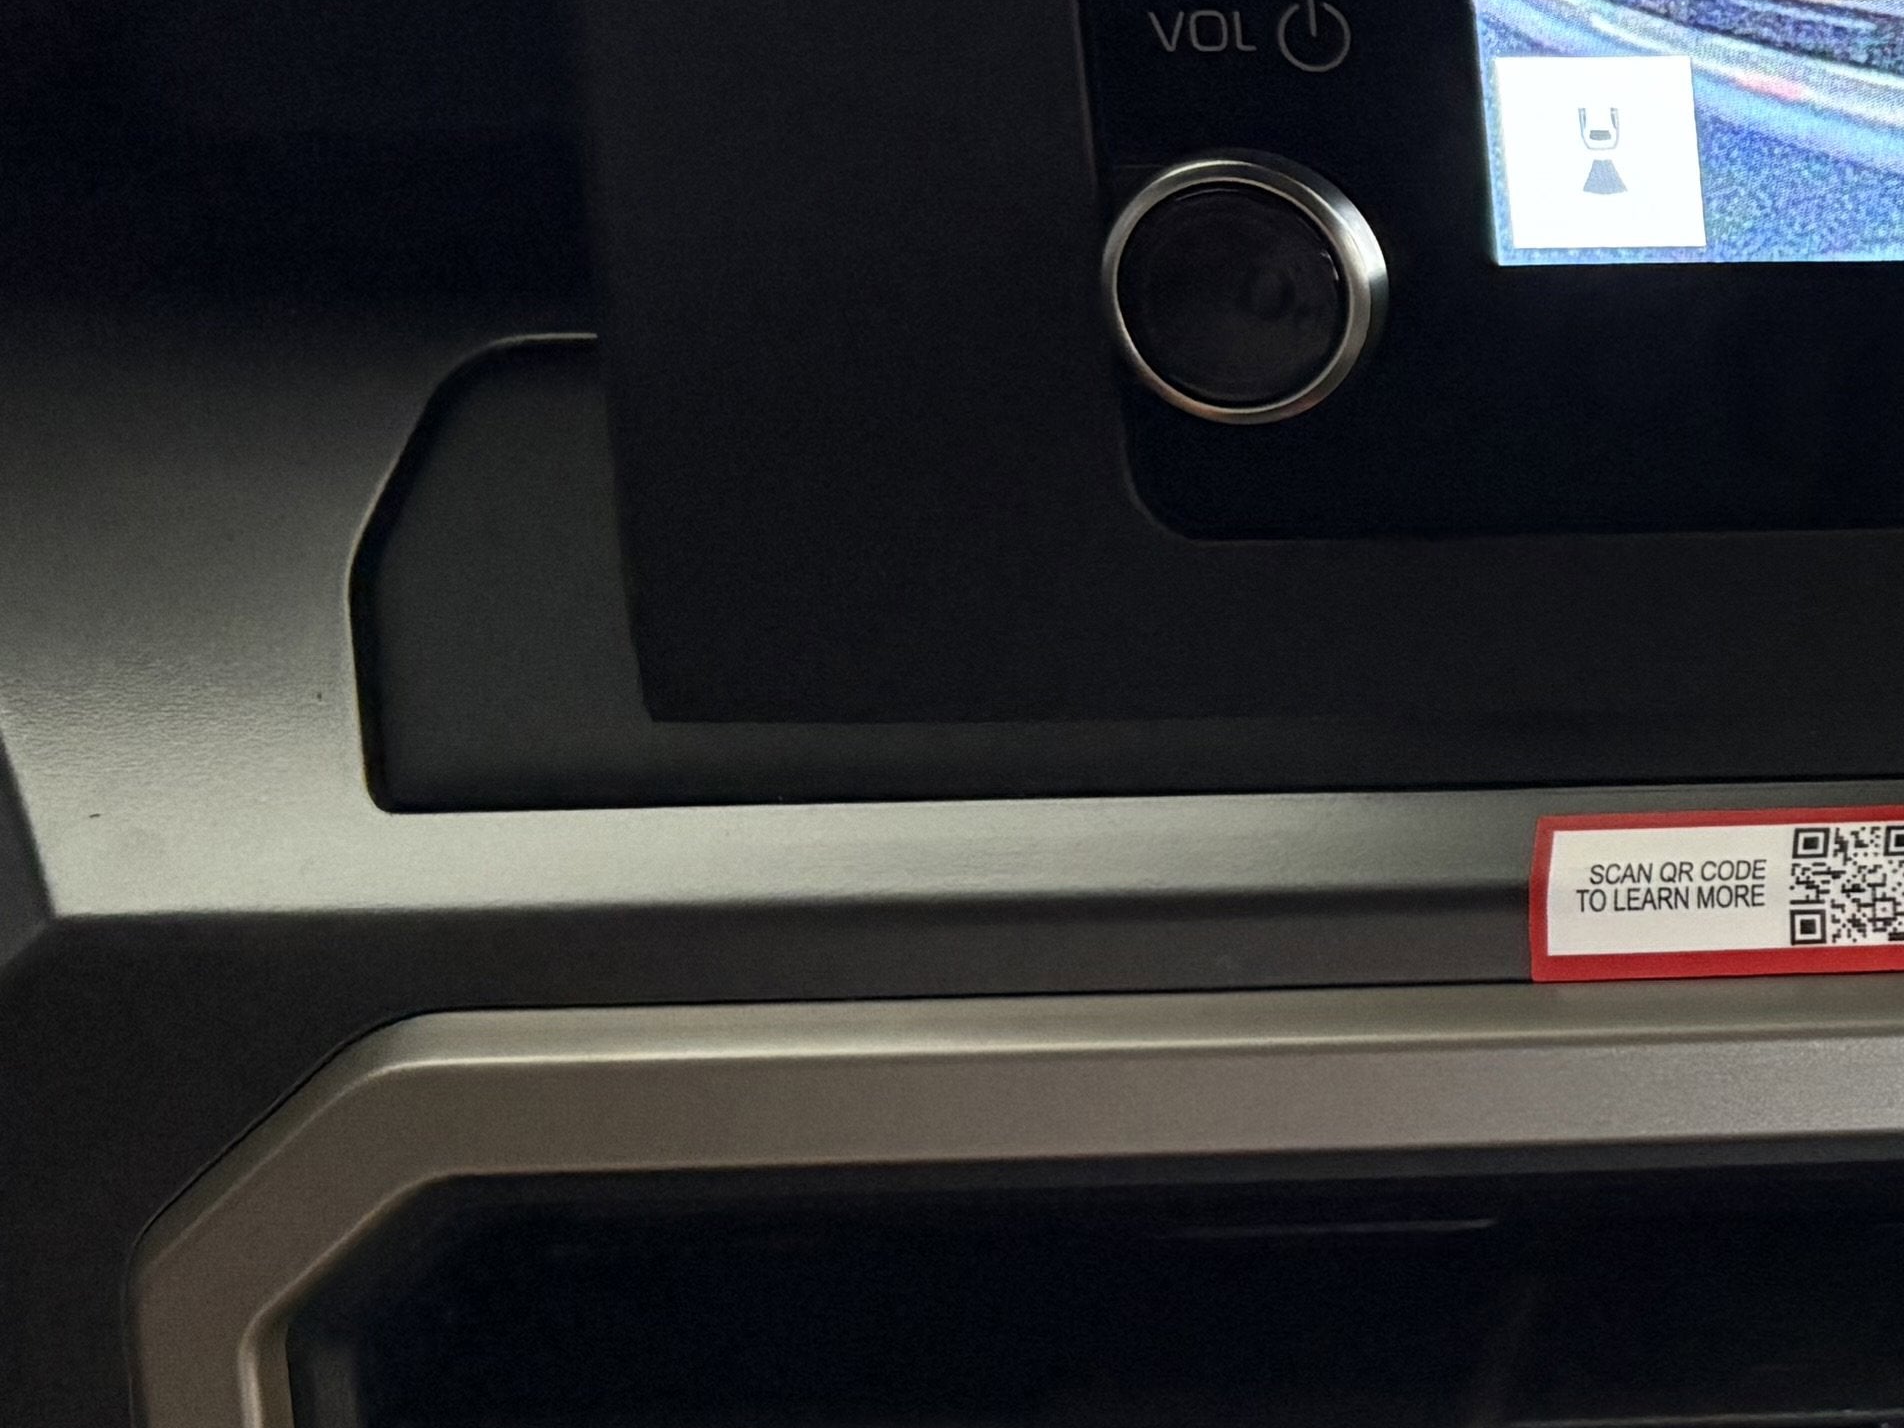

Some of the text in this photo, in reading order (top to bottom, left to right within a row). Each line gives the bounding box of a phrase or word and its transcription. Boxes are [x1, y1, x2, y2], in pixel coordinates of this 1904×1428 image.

[1148, 10, 1257, 52] VOL
[1589, 859, 1767, 885] SCAN QR CODE
[1576, 884, 1766, 912] TO LEARN MORE
